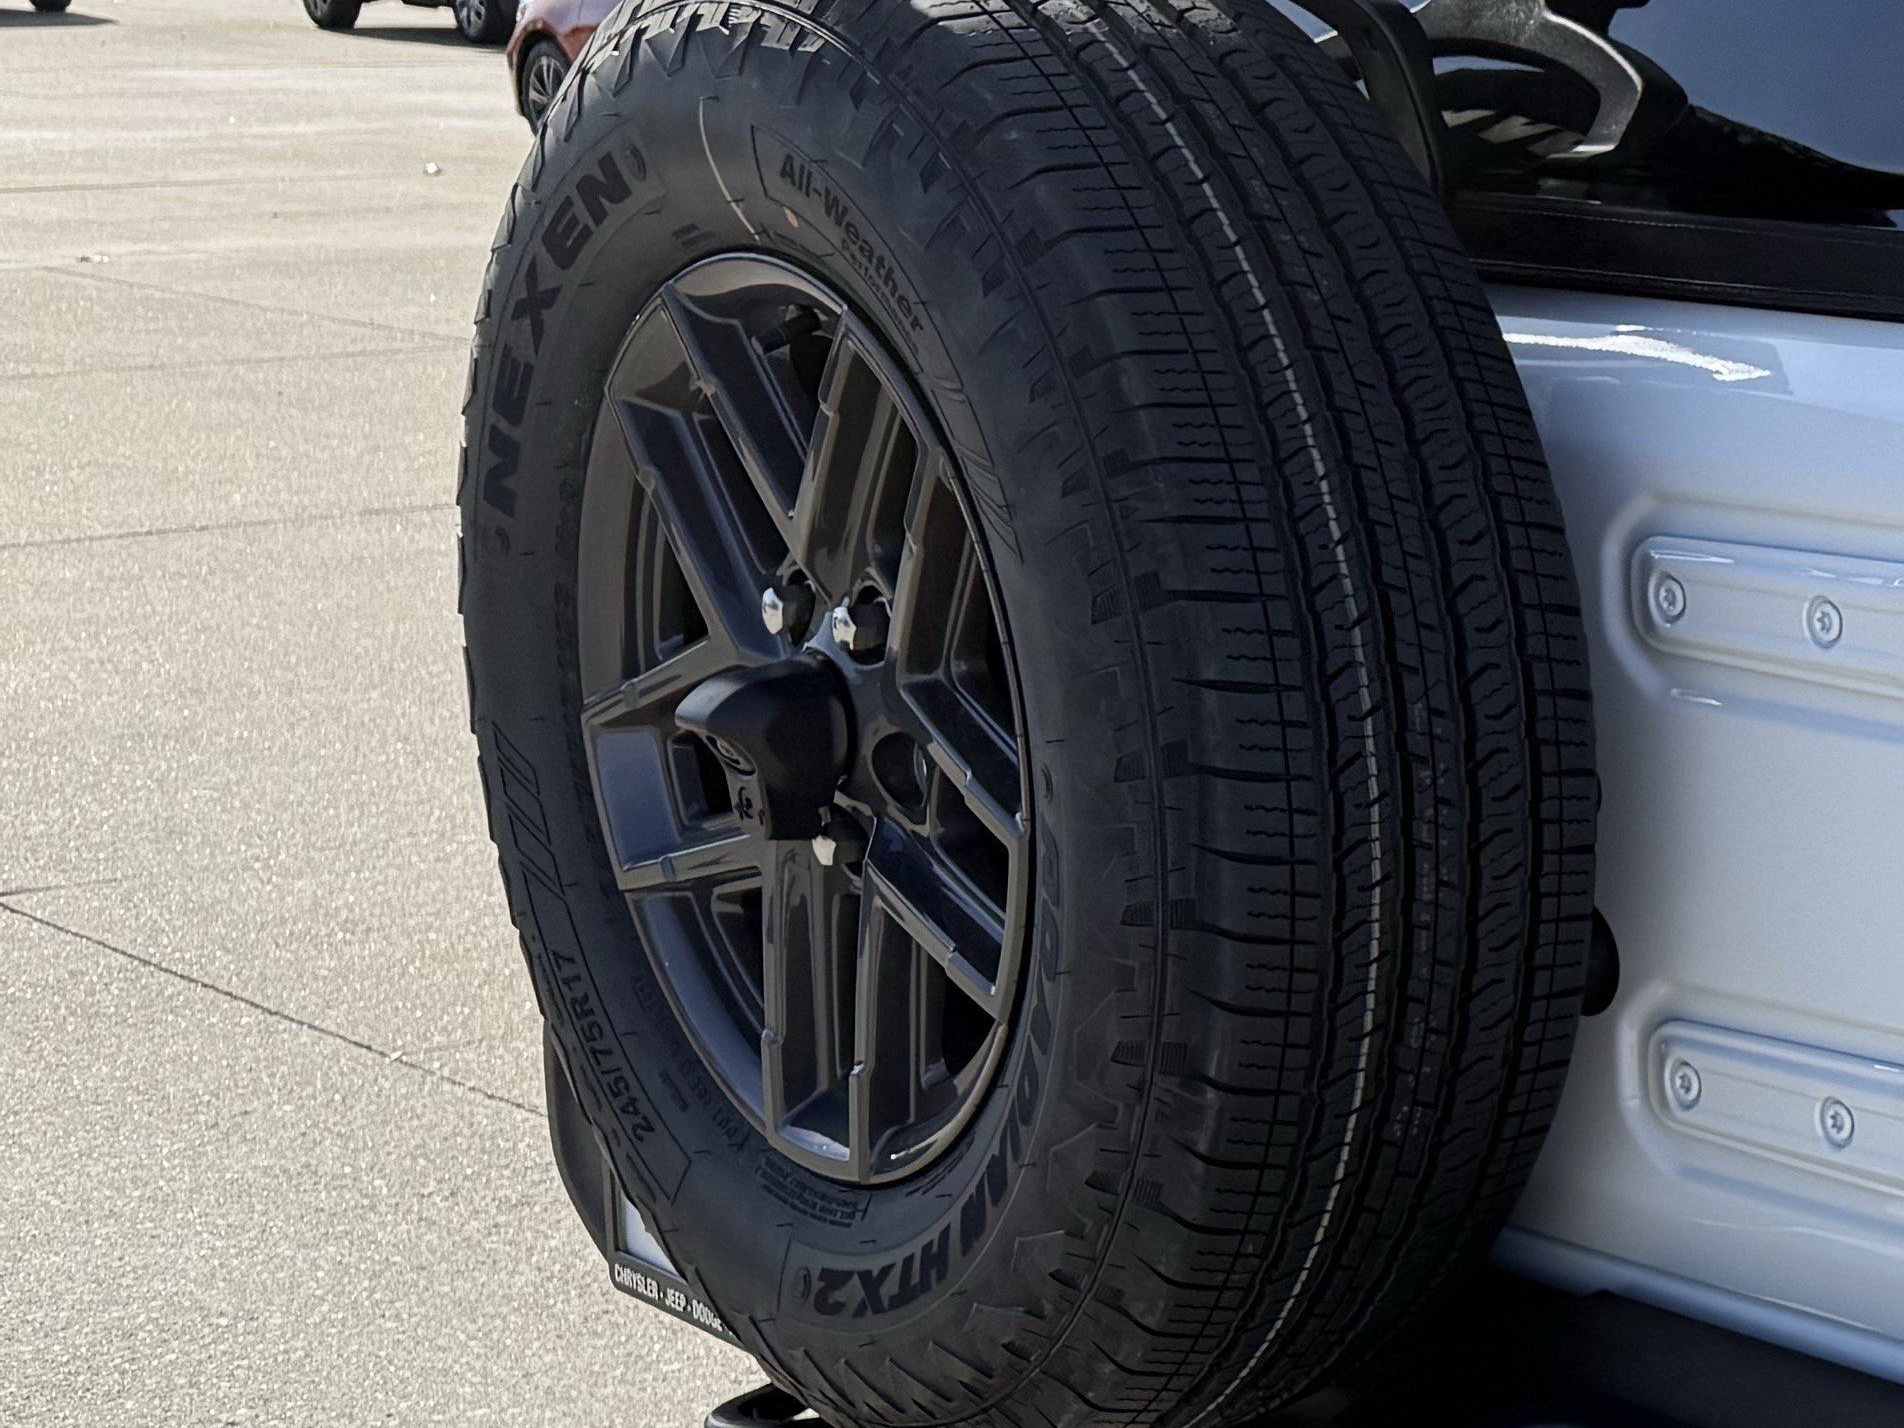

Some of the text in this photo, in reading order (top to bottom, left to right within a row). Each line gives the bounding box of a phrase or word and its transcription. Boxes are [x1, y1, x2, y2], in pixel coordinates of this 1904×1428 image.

[482, 149, 634, 520] NEXEN
[777, 153, 928, 335] All-Weather
[549, 946, 657, 1147] 245/75R17
[665, 1286, 687, 1313] JEEP
[813, 1222, 952, 1317] HTX2
